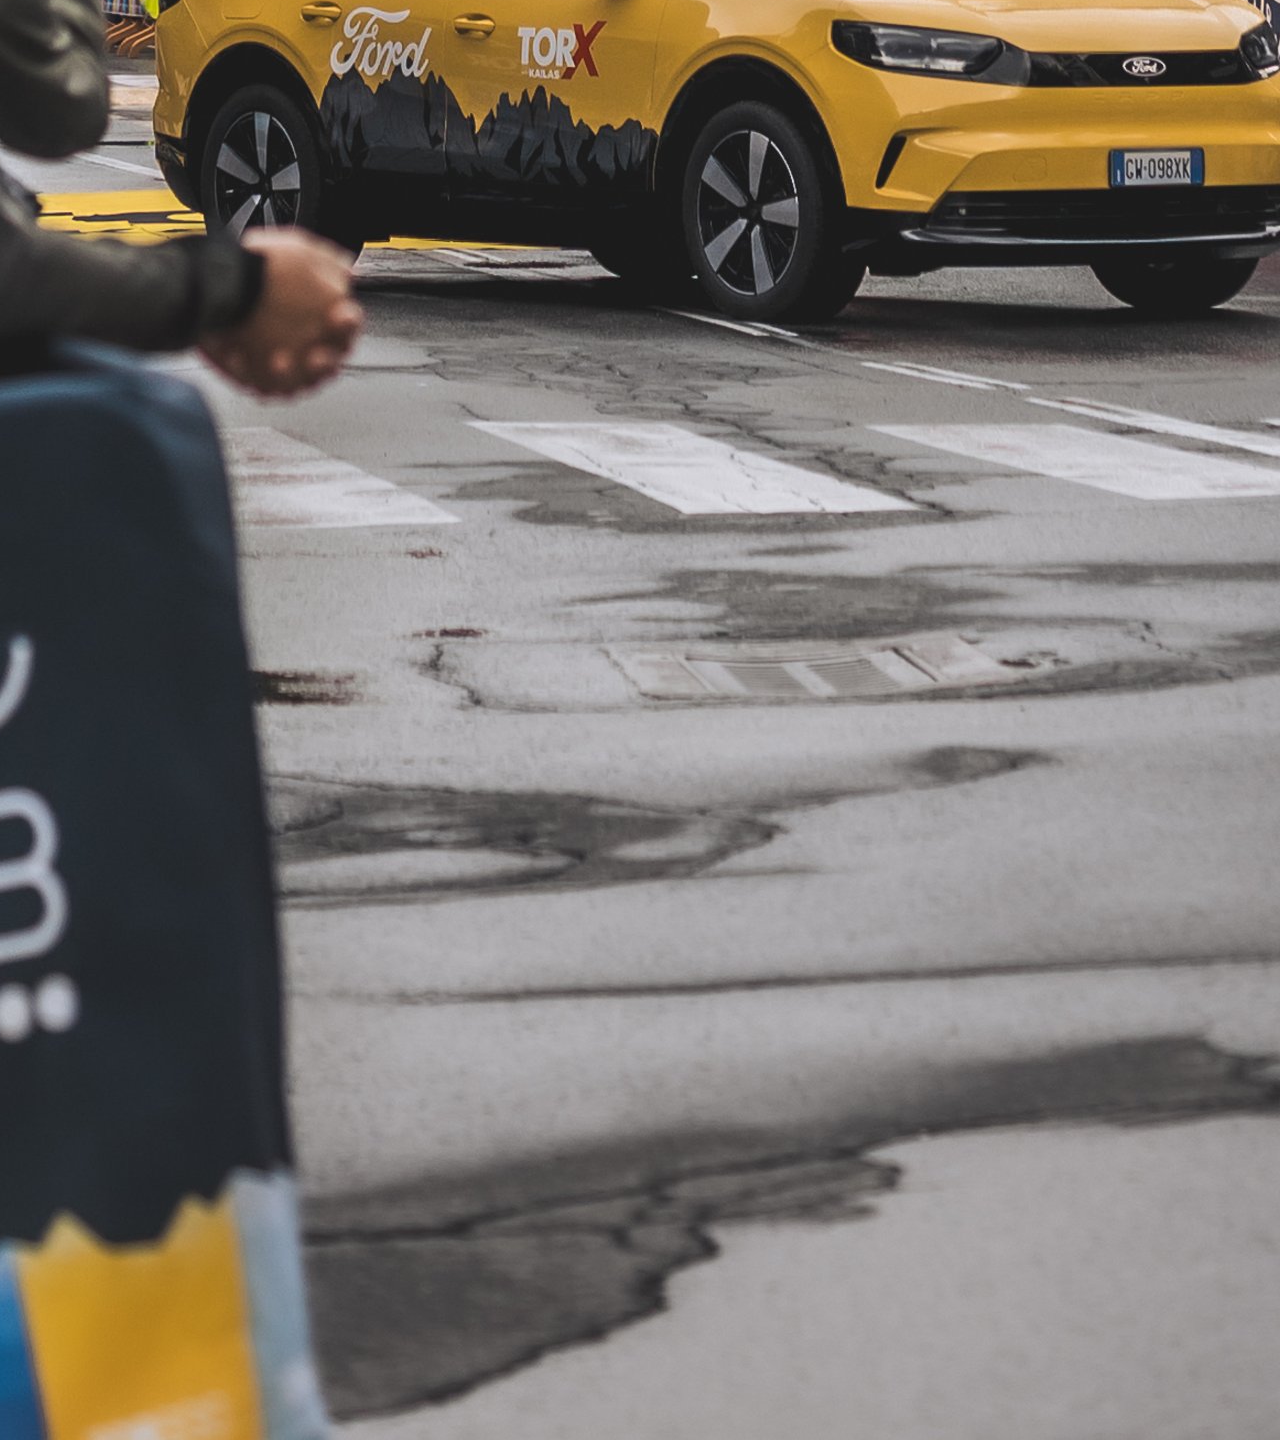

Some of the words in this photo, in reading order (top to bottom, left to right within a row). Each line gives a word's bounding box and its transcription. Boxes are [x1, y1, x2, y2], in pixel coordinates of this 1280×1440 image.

[330, 6, 432, 78] Ford
[517, 20, 608, 79] TORX
[528, 68, 560, 79] KAILAS
[1131, 59, 1158, 74] Ford
